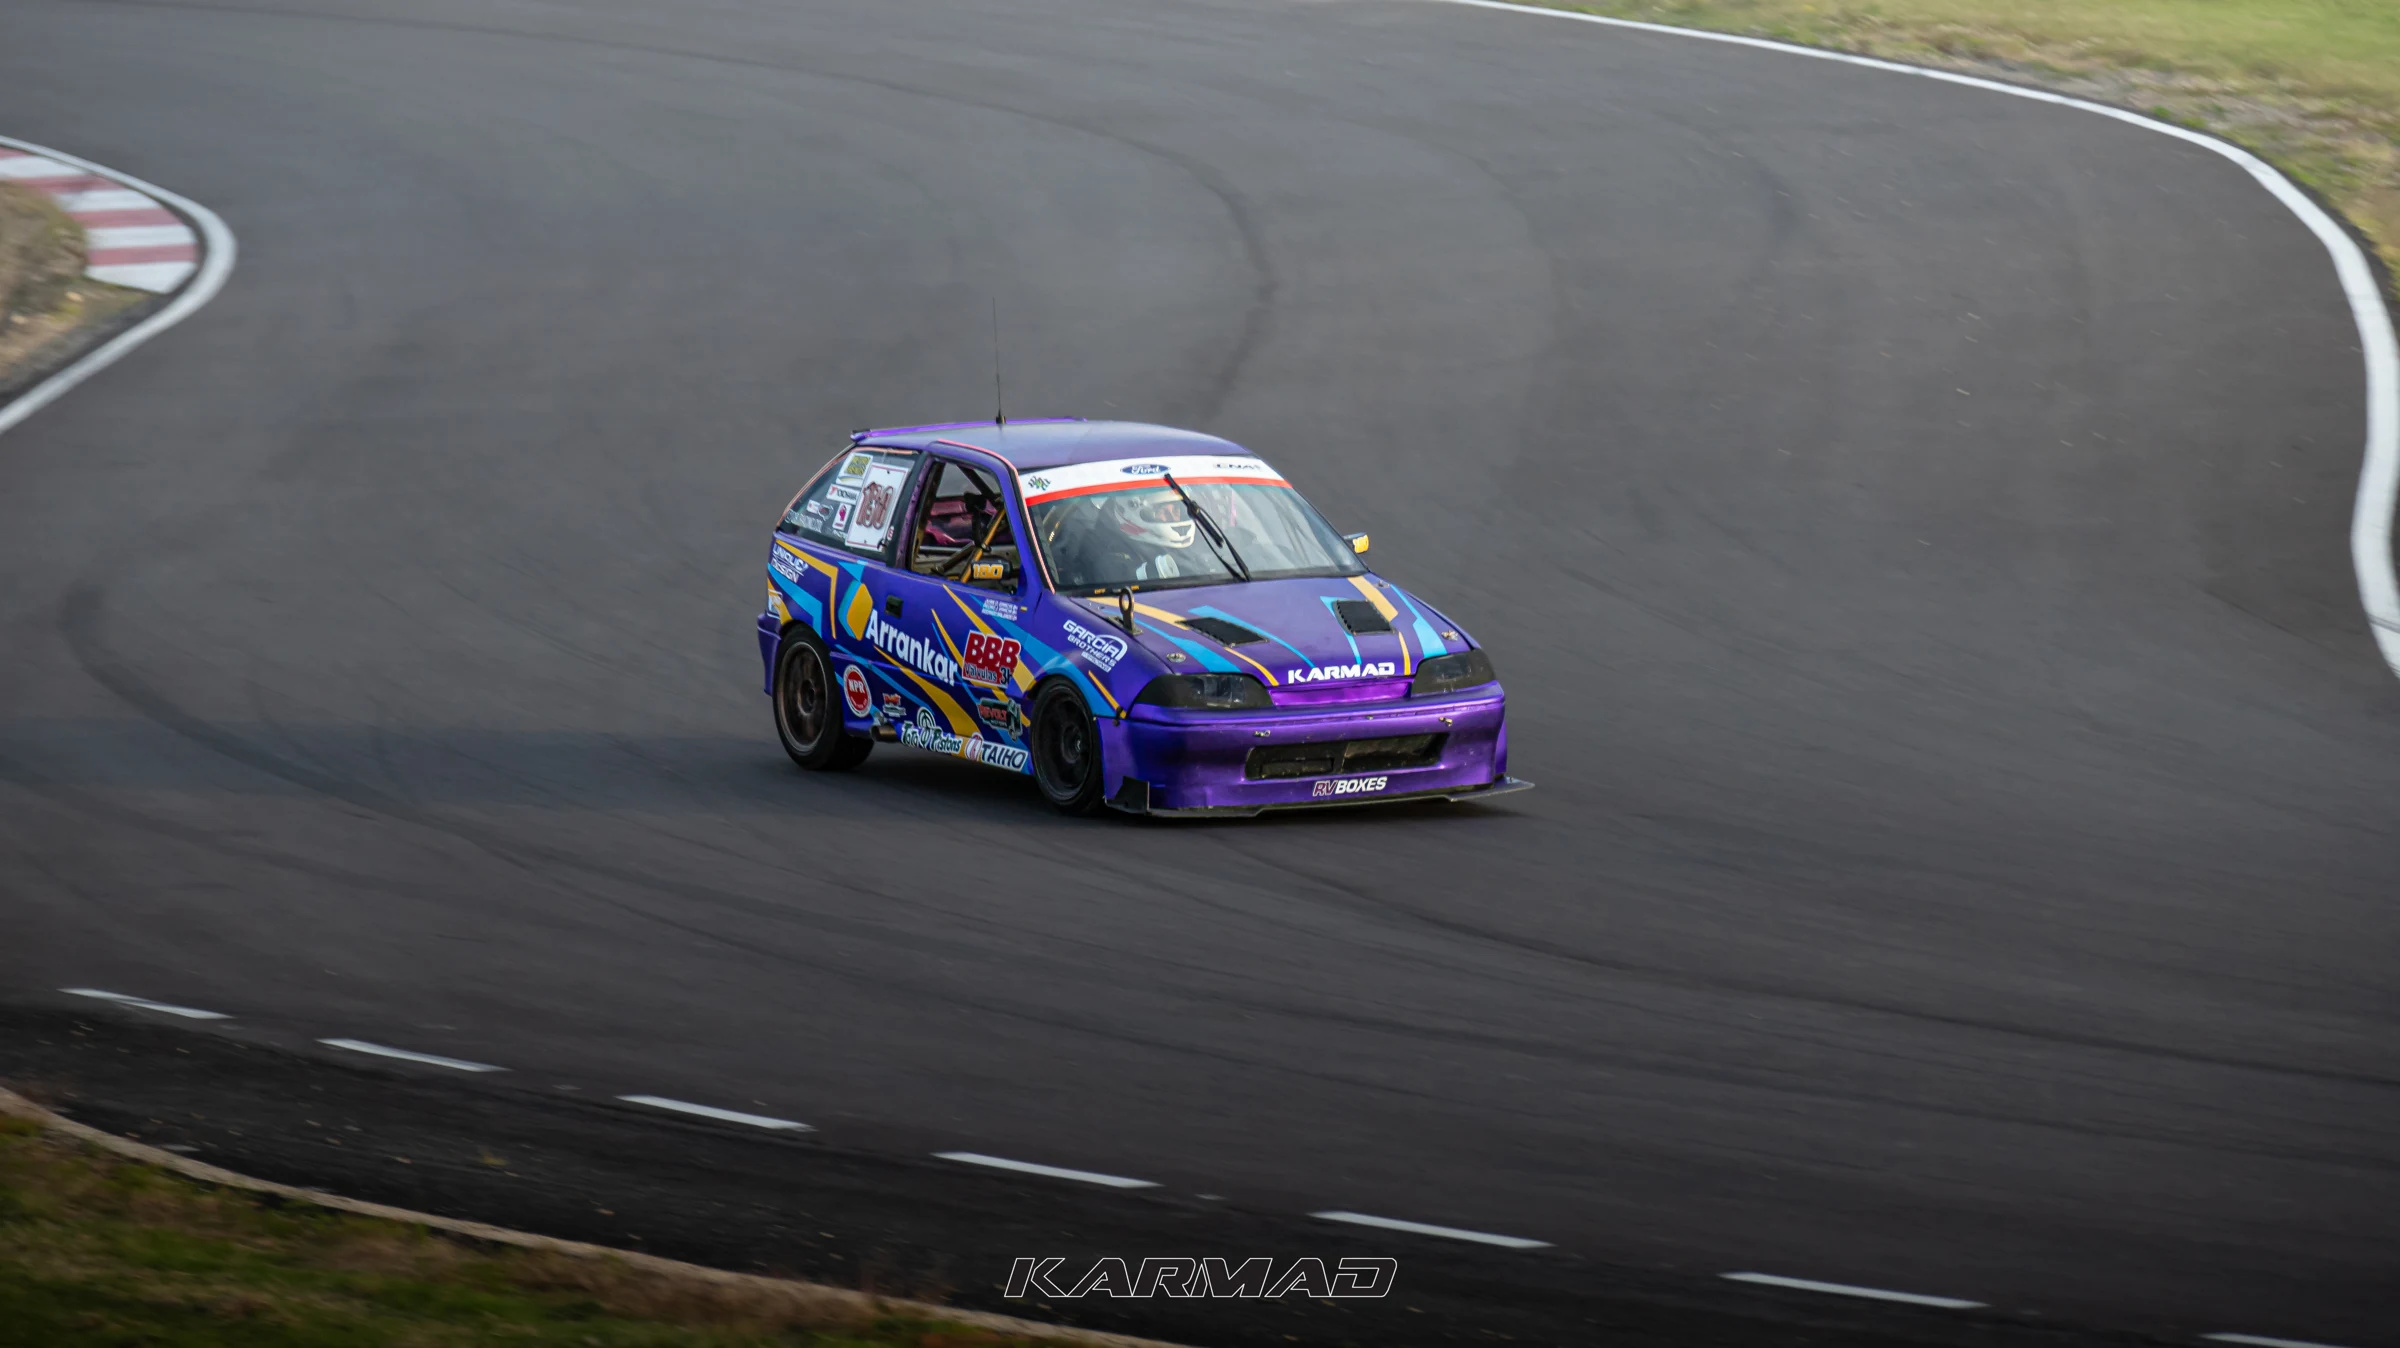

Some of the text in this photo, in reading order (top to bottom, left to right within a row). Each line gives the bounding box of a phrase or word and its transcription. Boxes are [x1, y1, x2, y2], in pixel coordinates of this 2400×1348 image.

[1131, 464, 1161, 475] Ford
[973, 563, 1004, 579] 180
[865, 608, 958, 687] Arrankar
[964, 631, 1020, 670] BBB
[1067, 633, 1117, 667] BROTHERS
[1287, 661, 1396, 685] KARMAD
[930, 726, 963, 754] Pistons
[981, 744, 1027, 768] TAIHO
